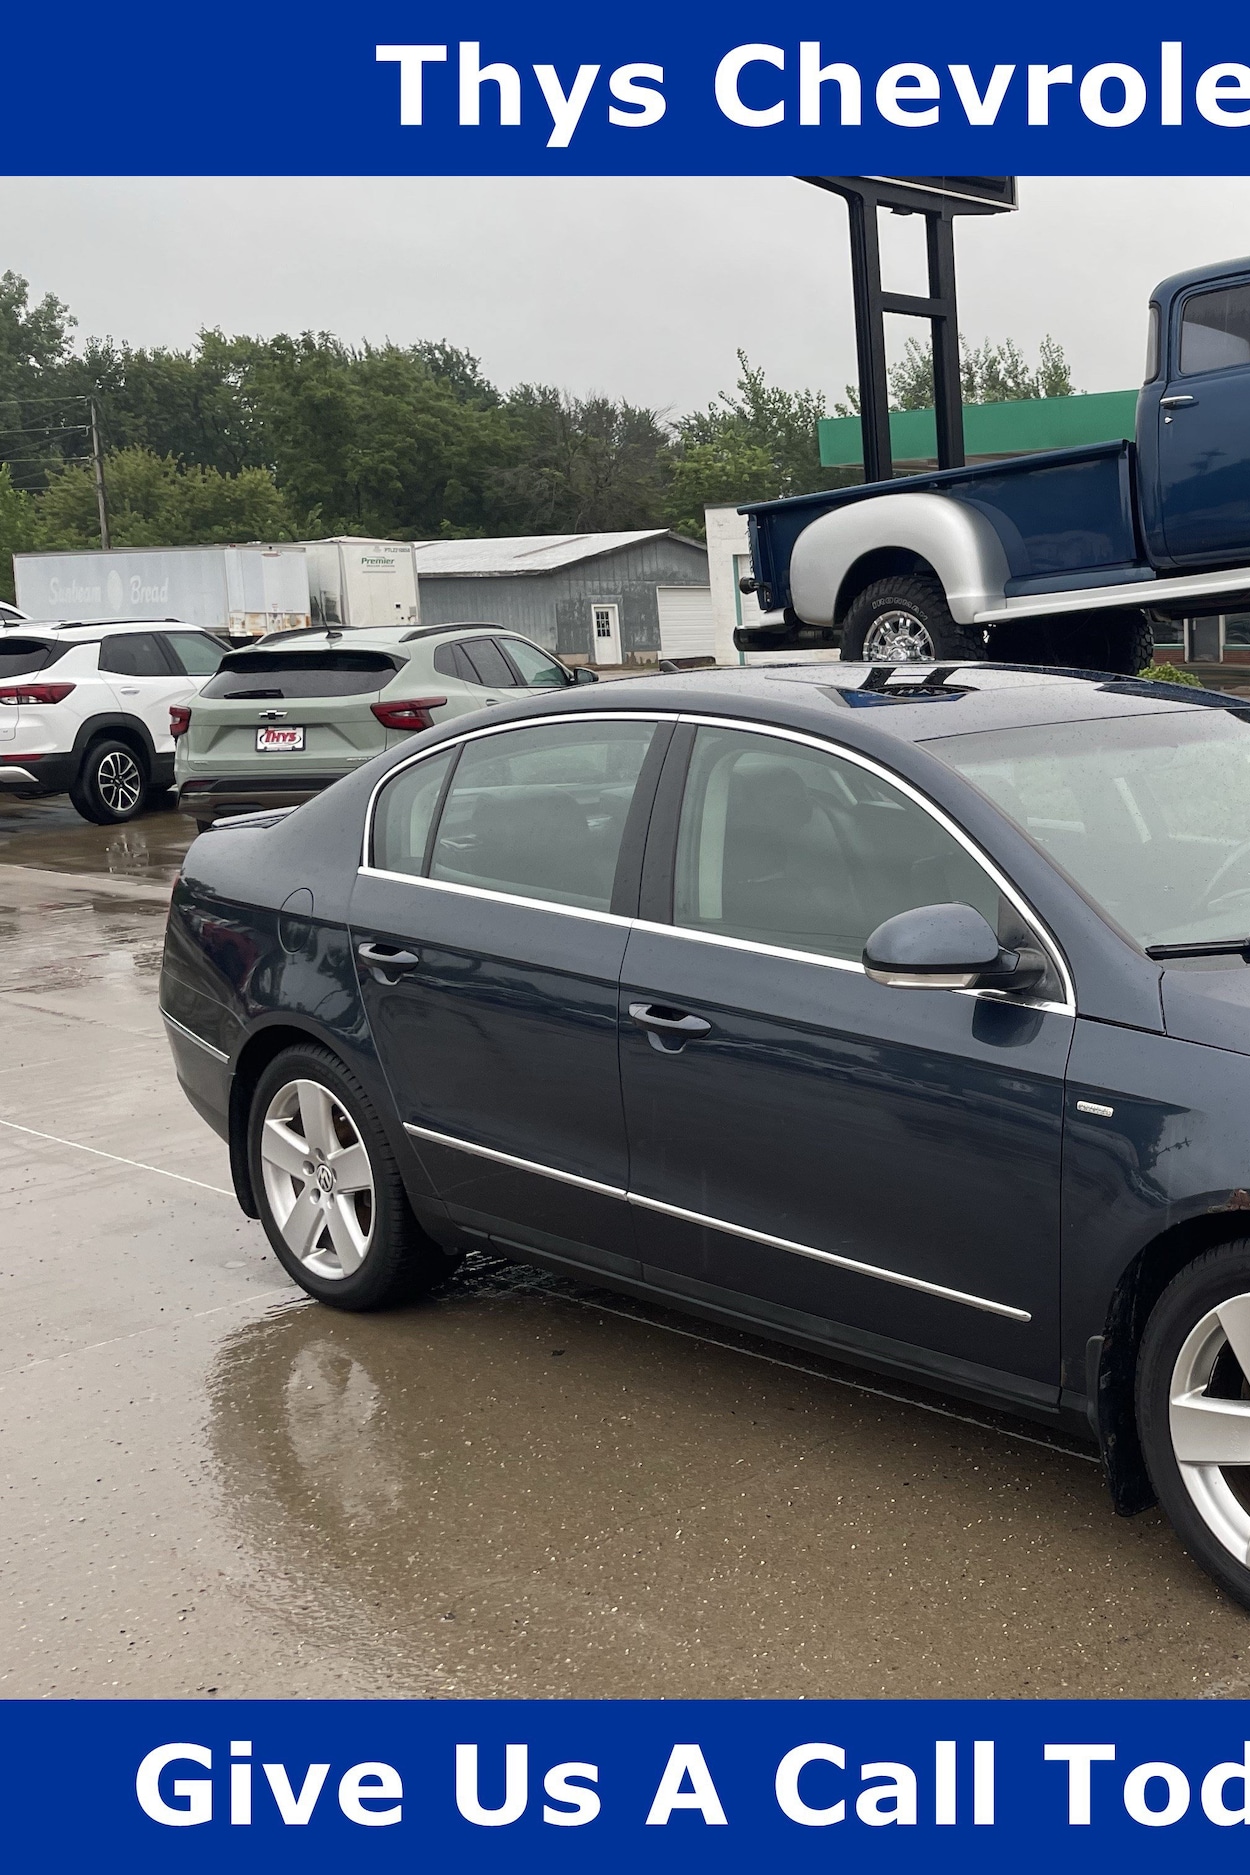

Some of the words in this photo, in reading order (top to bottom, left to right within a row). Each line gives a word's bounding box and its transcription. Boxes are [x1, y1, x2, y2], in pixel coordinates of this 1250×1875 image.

[361, 556, 395, 565] Premier
[130, 575, 169, 605] Bread
[871, 596, 928, 621] IRONMAN
[264, 729, 297, 744] THYS
